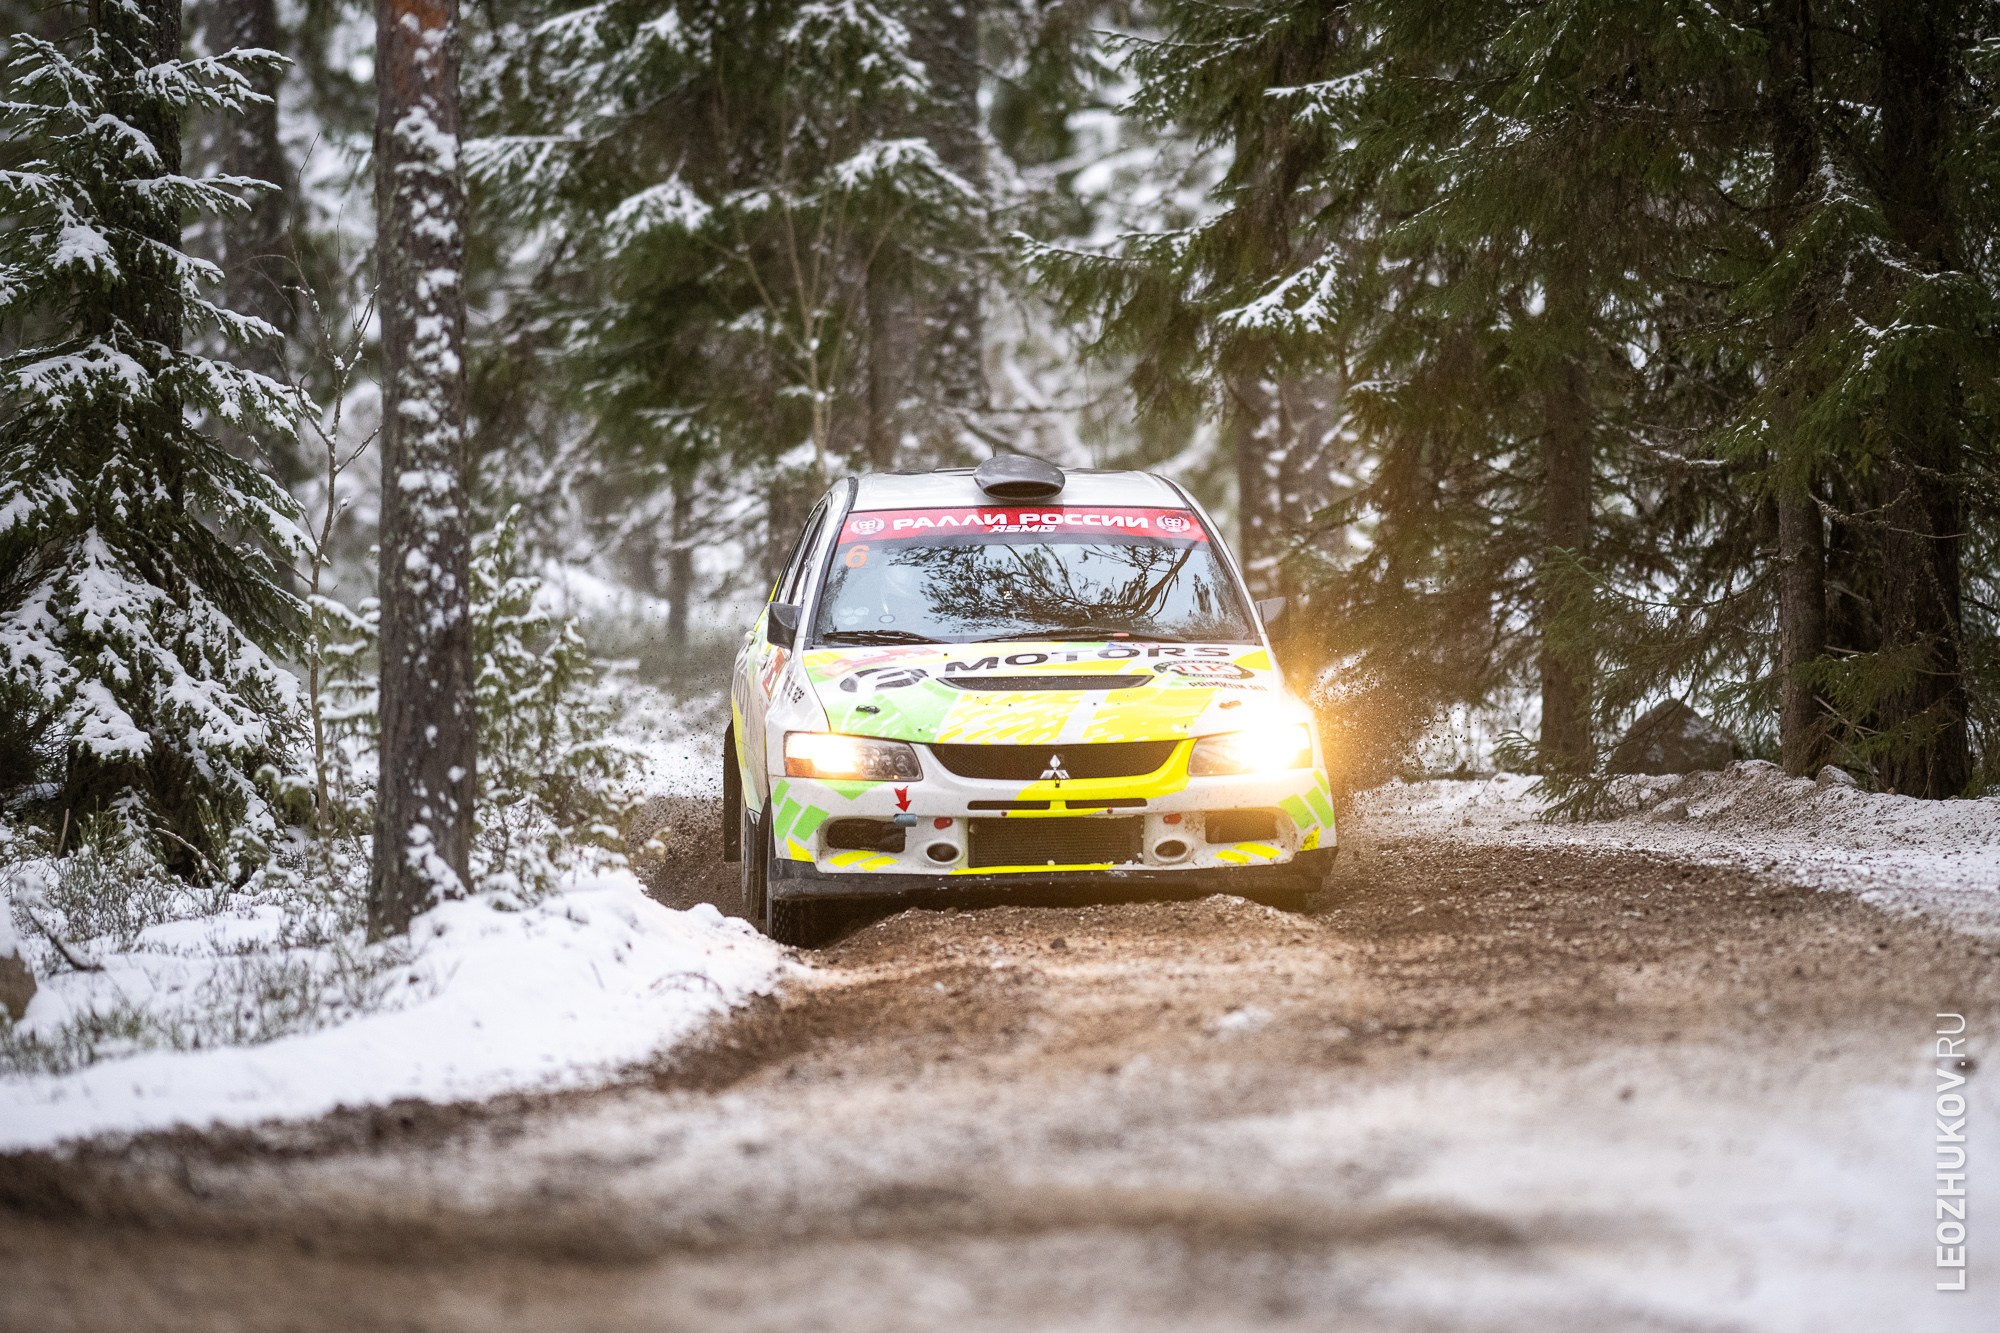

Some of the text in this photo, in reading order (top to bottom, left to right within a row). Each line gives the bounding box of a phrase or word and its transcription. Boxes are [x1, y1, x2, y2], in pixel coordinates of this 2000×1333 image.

[893, 513, 1149, 531] РАЛЛИ РОССИИ
[845, 545, 870, 568] 6
[944, 646, 1230, 678] MOTORS
